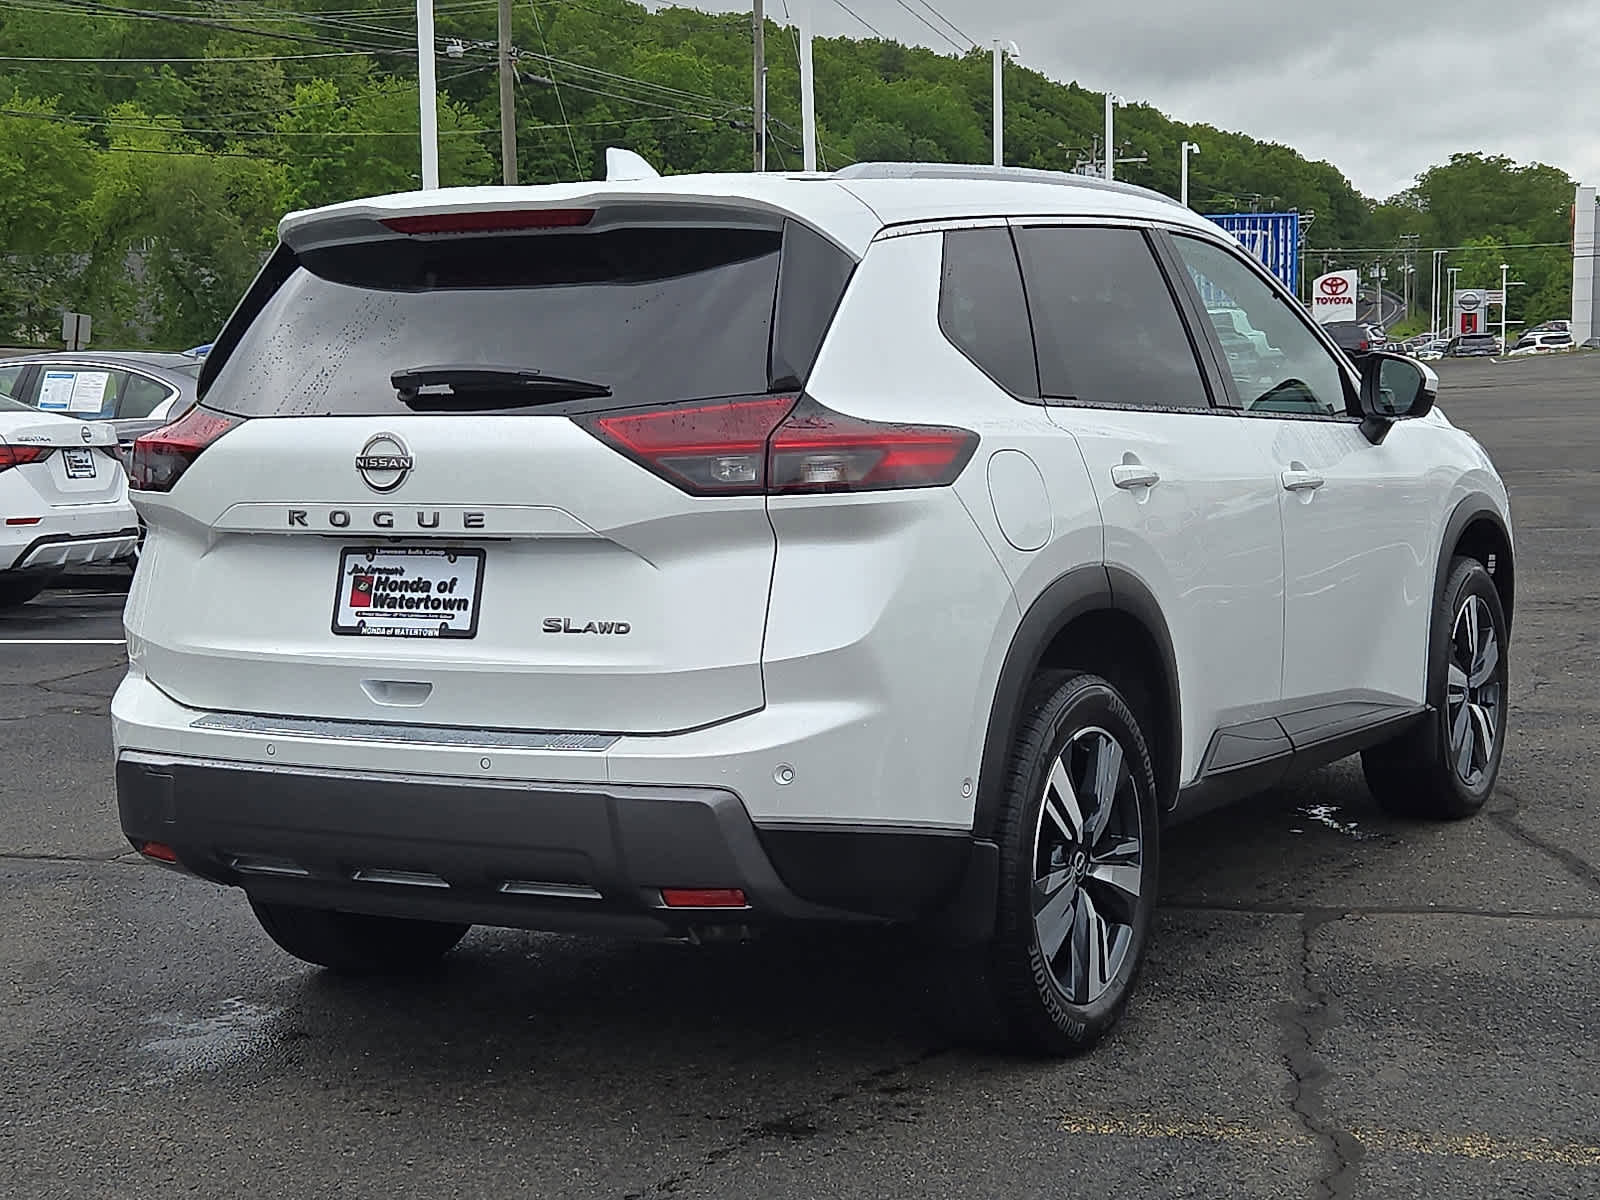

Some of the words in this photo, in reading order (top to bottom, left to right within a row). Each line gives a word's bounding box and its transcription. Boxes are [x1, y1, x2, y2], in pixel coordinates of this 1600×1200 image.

[1315, 296, 1353, 305] TOYOTA
[356, 457, 411, 468] NISSAN
[288, 509, 485, 529] ROGUE
[374, 576, 432, 593] Honda
[437, 577, 458, 593] of
[373, 593, 469, 611] Watertown
[361, 627, 386, 635] HONDA
[394, 627, 440, 637] WATERTOWN
[1028, 943, 1086, 1041] BRIDGESTONE
